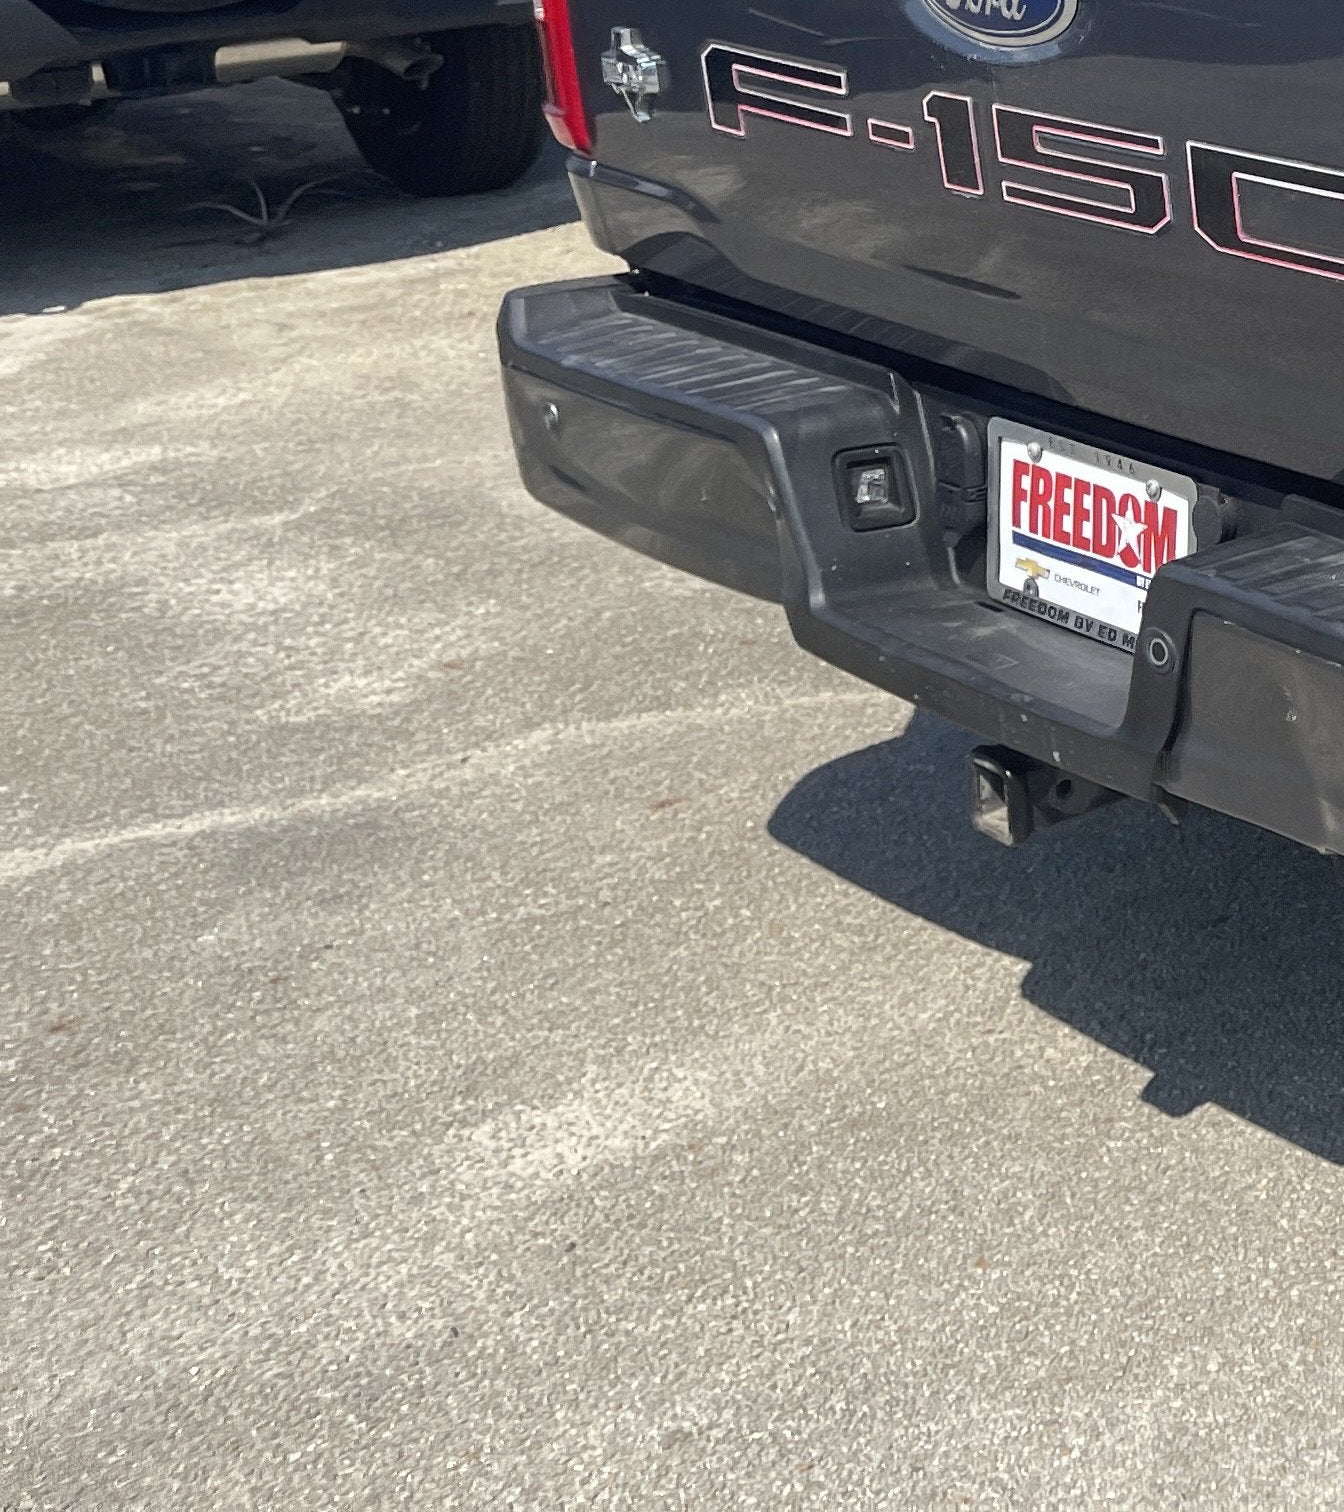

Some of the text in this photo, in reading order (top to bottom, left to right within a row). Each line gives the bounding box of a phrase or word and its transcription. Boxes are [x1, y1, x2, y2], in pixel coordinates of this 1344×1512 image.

[1011, 458, 1178, 574] FREEDOM
[1054, 573, 1101, 596] CHEVROLET
[1002, 588, 1070, 625] FREEDOM
[1074, 615, 1094, 633] BY
[1097, 623, 1118, 642] ED
